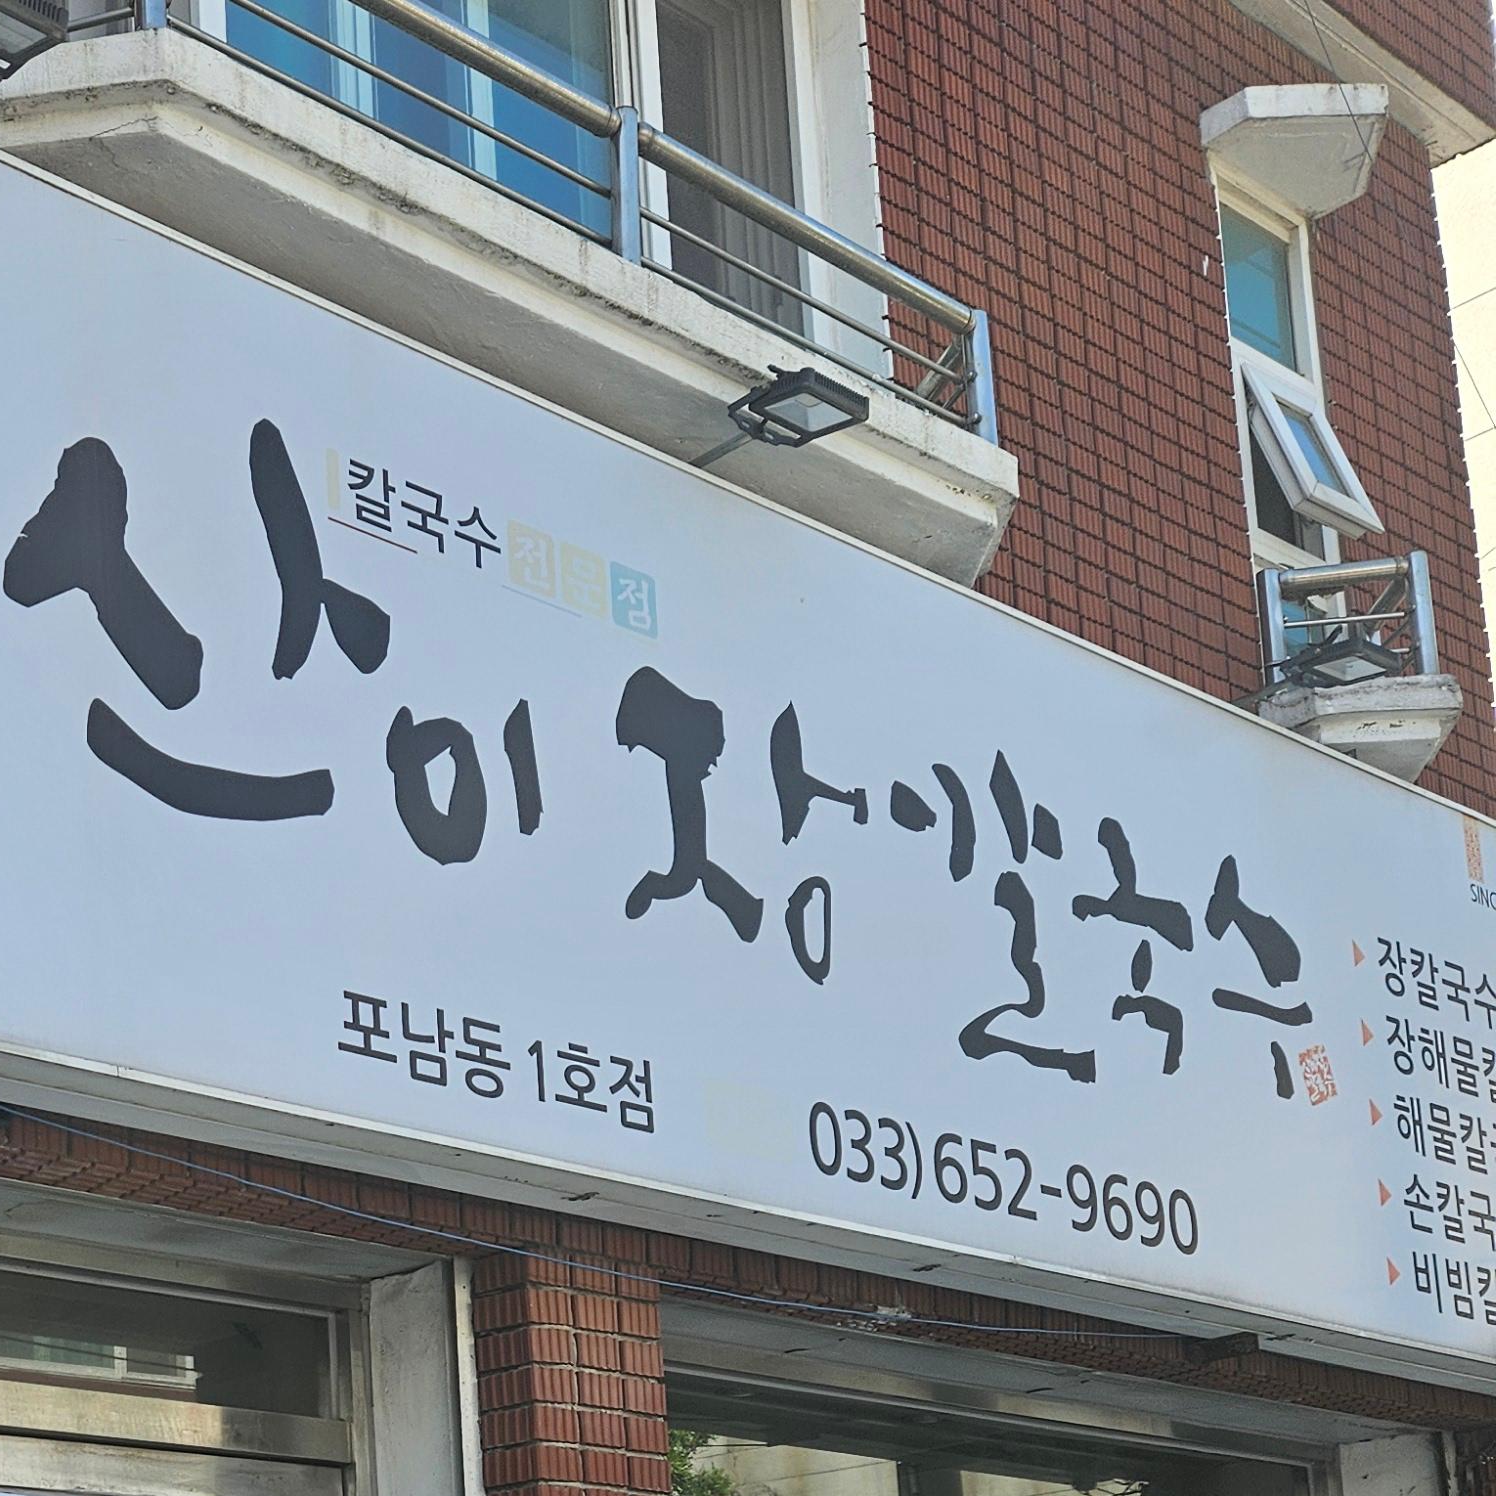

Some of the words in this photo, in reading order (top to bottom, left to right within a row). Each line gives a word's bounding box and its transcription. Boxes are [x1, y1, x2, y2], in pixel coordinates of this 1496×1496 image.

[346, 457, 502, 570] 칼국수
[3, 418, 544, 866] 산이
[615, 665, 1313, 1100] 장칼국수
[338, 990, 509, 1099] 포남동
[528, 1038, 655, 1133] 1호점
[809, 1101, 1198, 1254] 033)652-9690
[1393, 1095, 1496, 1175] 해물칼
